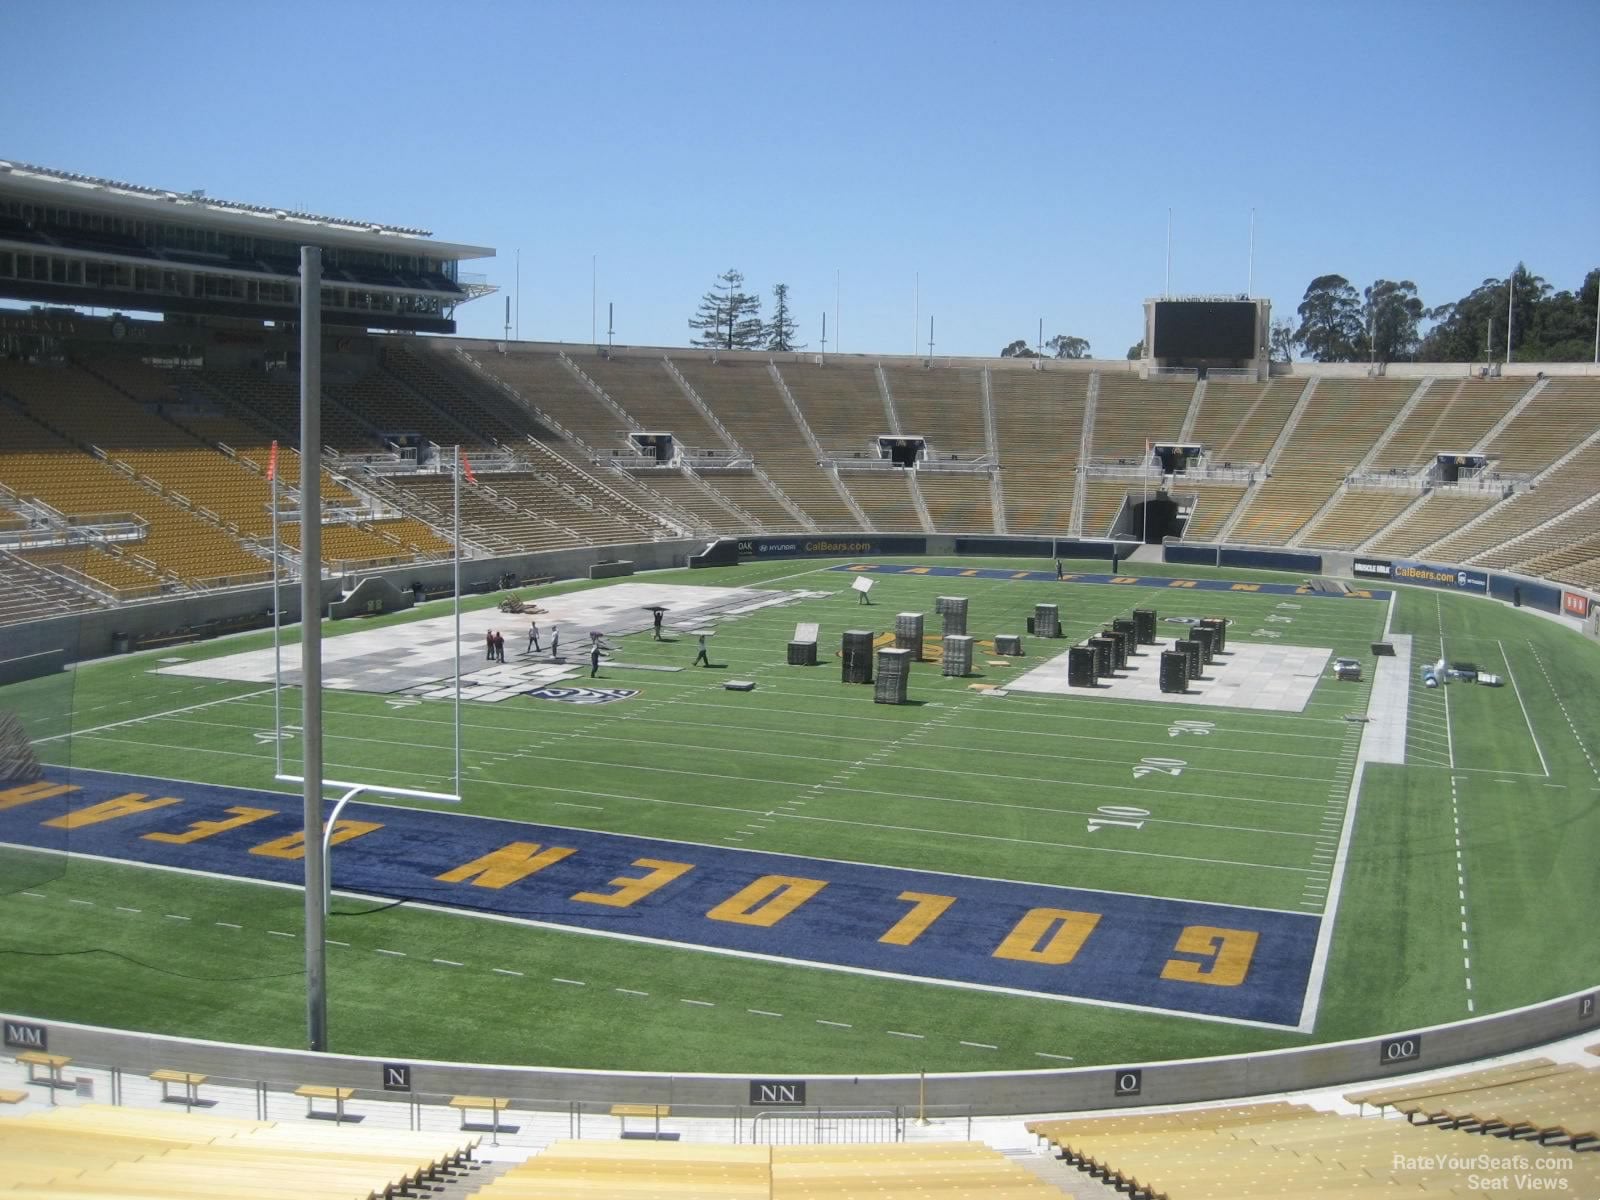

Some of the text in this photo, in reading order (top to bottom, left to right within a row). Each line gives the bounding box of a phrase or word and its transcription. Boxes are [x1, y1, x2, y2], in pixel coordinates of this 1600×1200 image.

[805, 541, 871, 551] CalBears.com
[1395, 566, 1455, 583] CalBears.com
[1132, 757, 1188, 776] 20
[1087, 805, 1150, 830] 10
[433, 841, 1260, 987] GOLDEN
[8, 1024, 42, 1046] MM
[1387, 1040, 1414, 1060] OO
[389, 1069, 407, 1086] N
[1119, 1073, 1137, 1091] O
[760, 1085, 796, 1102] NN
